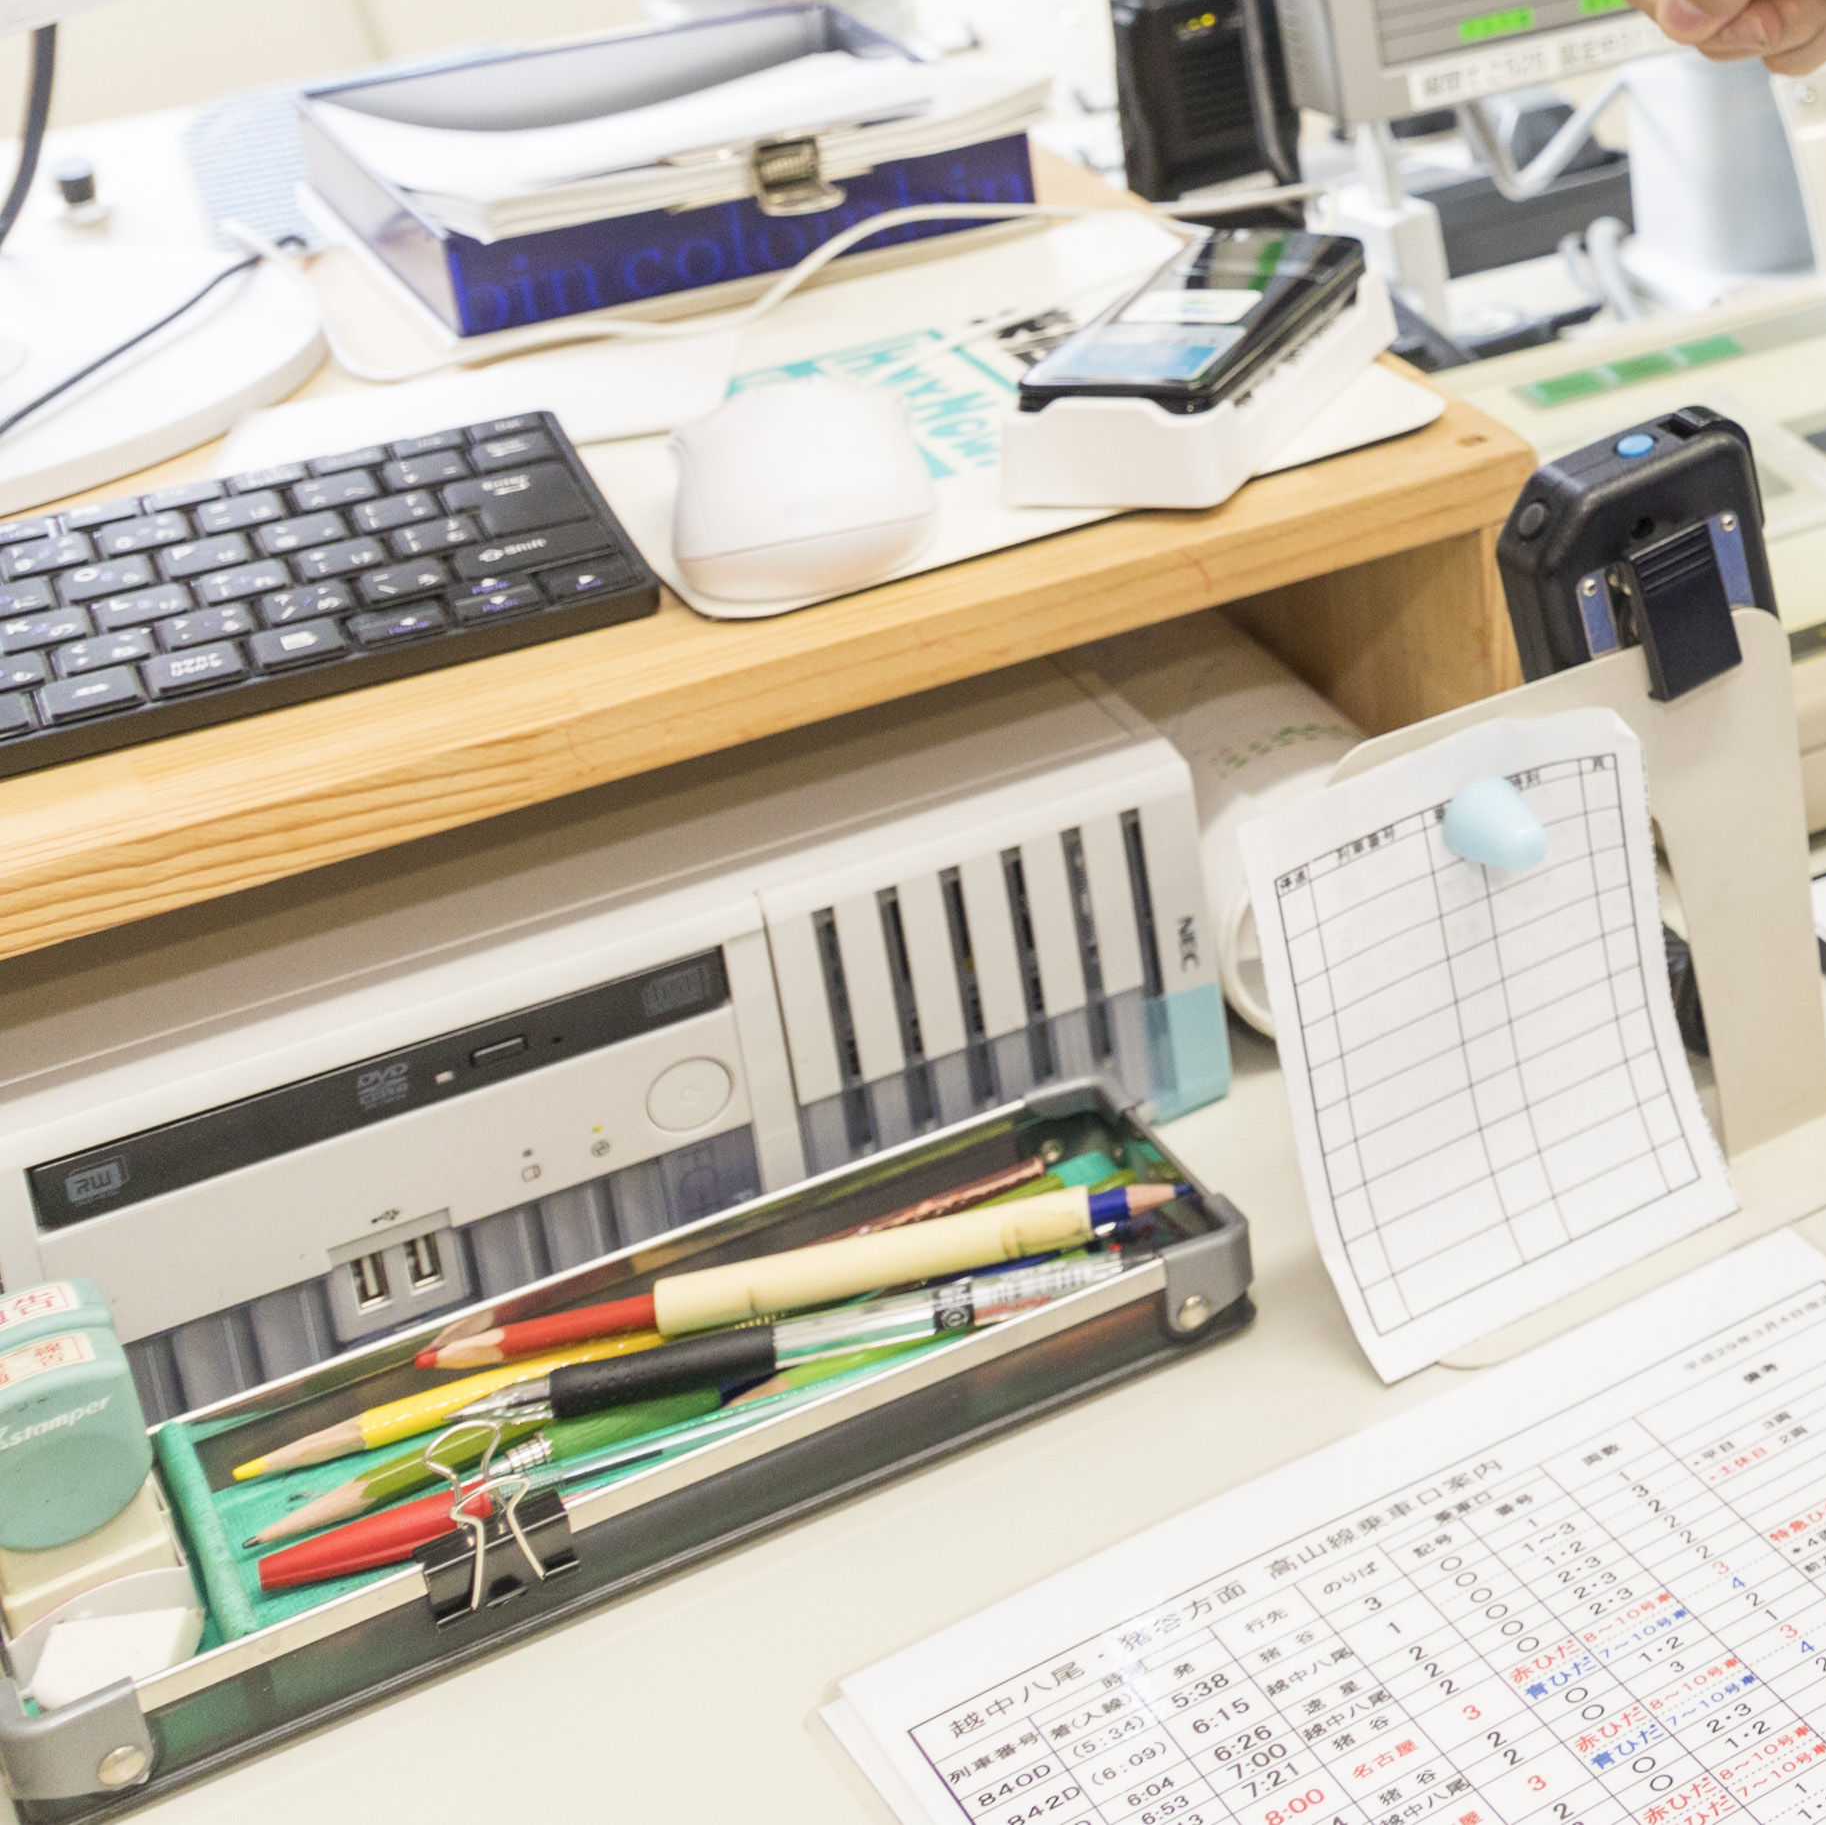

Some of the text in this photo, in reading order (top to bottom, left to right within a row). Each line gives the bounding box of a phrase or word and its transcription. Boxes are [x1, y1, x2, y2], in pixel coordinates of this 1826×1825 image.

[1618, 1471, 1631, 1482] 1
[1631, 1484, 1650, 1498] 3
[1495, 1493, 1534, 1518] 番号
[1648, 1499, 1667, 1513] 2
[1264, 1460, 1502, 1580] 高山線乗車口案内
[1527, 1517, 1538, 1528] 1
[1663, 1514, 1684, 1529] 2
[1412, 1533, 1453, 1559] 記号
[1680, 1530, 1698, 1545] 2
[1696, 1545, 1716, 1561] 2
[1712, 1560, 1730, 1575] 3
[1322, 1561, 1380, 1595] のりば
[1731, 1576, 1746, 1590] 4
[1363, 1596, 1383, 1611] 3
[1745, 1592, 1766, 1608] 2
[1244, 1608, 1289, 1635] 行先
[1763, 1608, 1778, 1621] 1
[1387, 1621, 1402, 1634] 1
[1780, 1623, 1799, 1639] 3
[1408, 1645, 1430, 1662] 2
[1798, 1639, 1815, 1655] 4
[1423, 1662, 1445, 1679] 2
[1508, 1639, 1581, 1684] 赤ひだ
[1668, 1660, 1685, 1673] 3
[1265, 1647, 1354, 1697] 越中八尾
[1525, 1655, 1598, 1700] 青ひだ
[1171, 1673, 1230, 1709] 5:38
[1439, 1679, 1460, 1695] 2
[1192, 1697, 1250, 1734] 6:15
[1302, 1689, 1392, 1742] 越中八尾
[1462, 1704, 1482, 1721] 3
[1573, 1705, 1648, 1754] 赤ひだ
[1214, 1725, 1273, 1763] 6:26
[1487, 1731, 1508, 1748] 2
[1590, 1723, 1665, 1770] 青ひだ
[947, 1730, 1041, 1785] 列車番号
[1226, 1742, 1288, 1781] 7:00
[1352, 1738, 1419, 1780] 名古屋
[1503, 1748, 1525, 1766] 2
[977, 1764, 1051, 1807] 840D
[1241, 1761, 1300, 1799] 7:21
[1527, 1774, 1547, 1792] 3
[1795, 1782, 1808, 1794] 1
[1127, 1776, 1175, 1807] 6:04
[1643, 1776, 1718, 1824] 赤ひだ
[1141, 1794, 1190, 1825] 6:53
[1264, 1788, 1326, 1825] 8:00
[1553, 1802, 1575, 1821] 2
